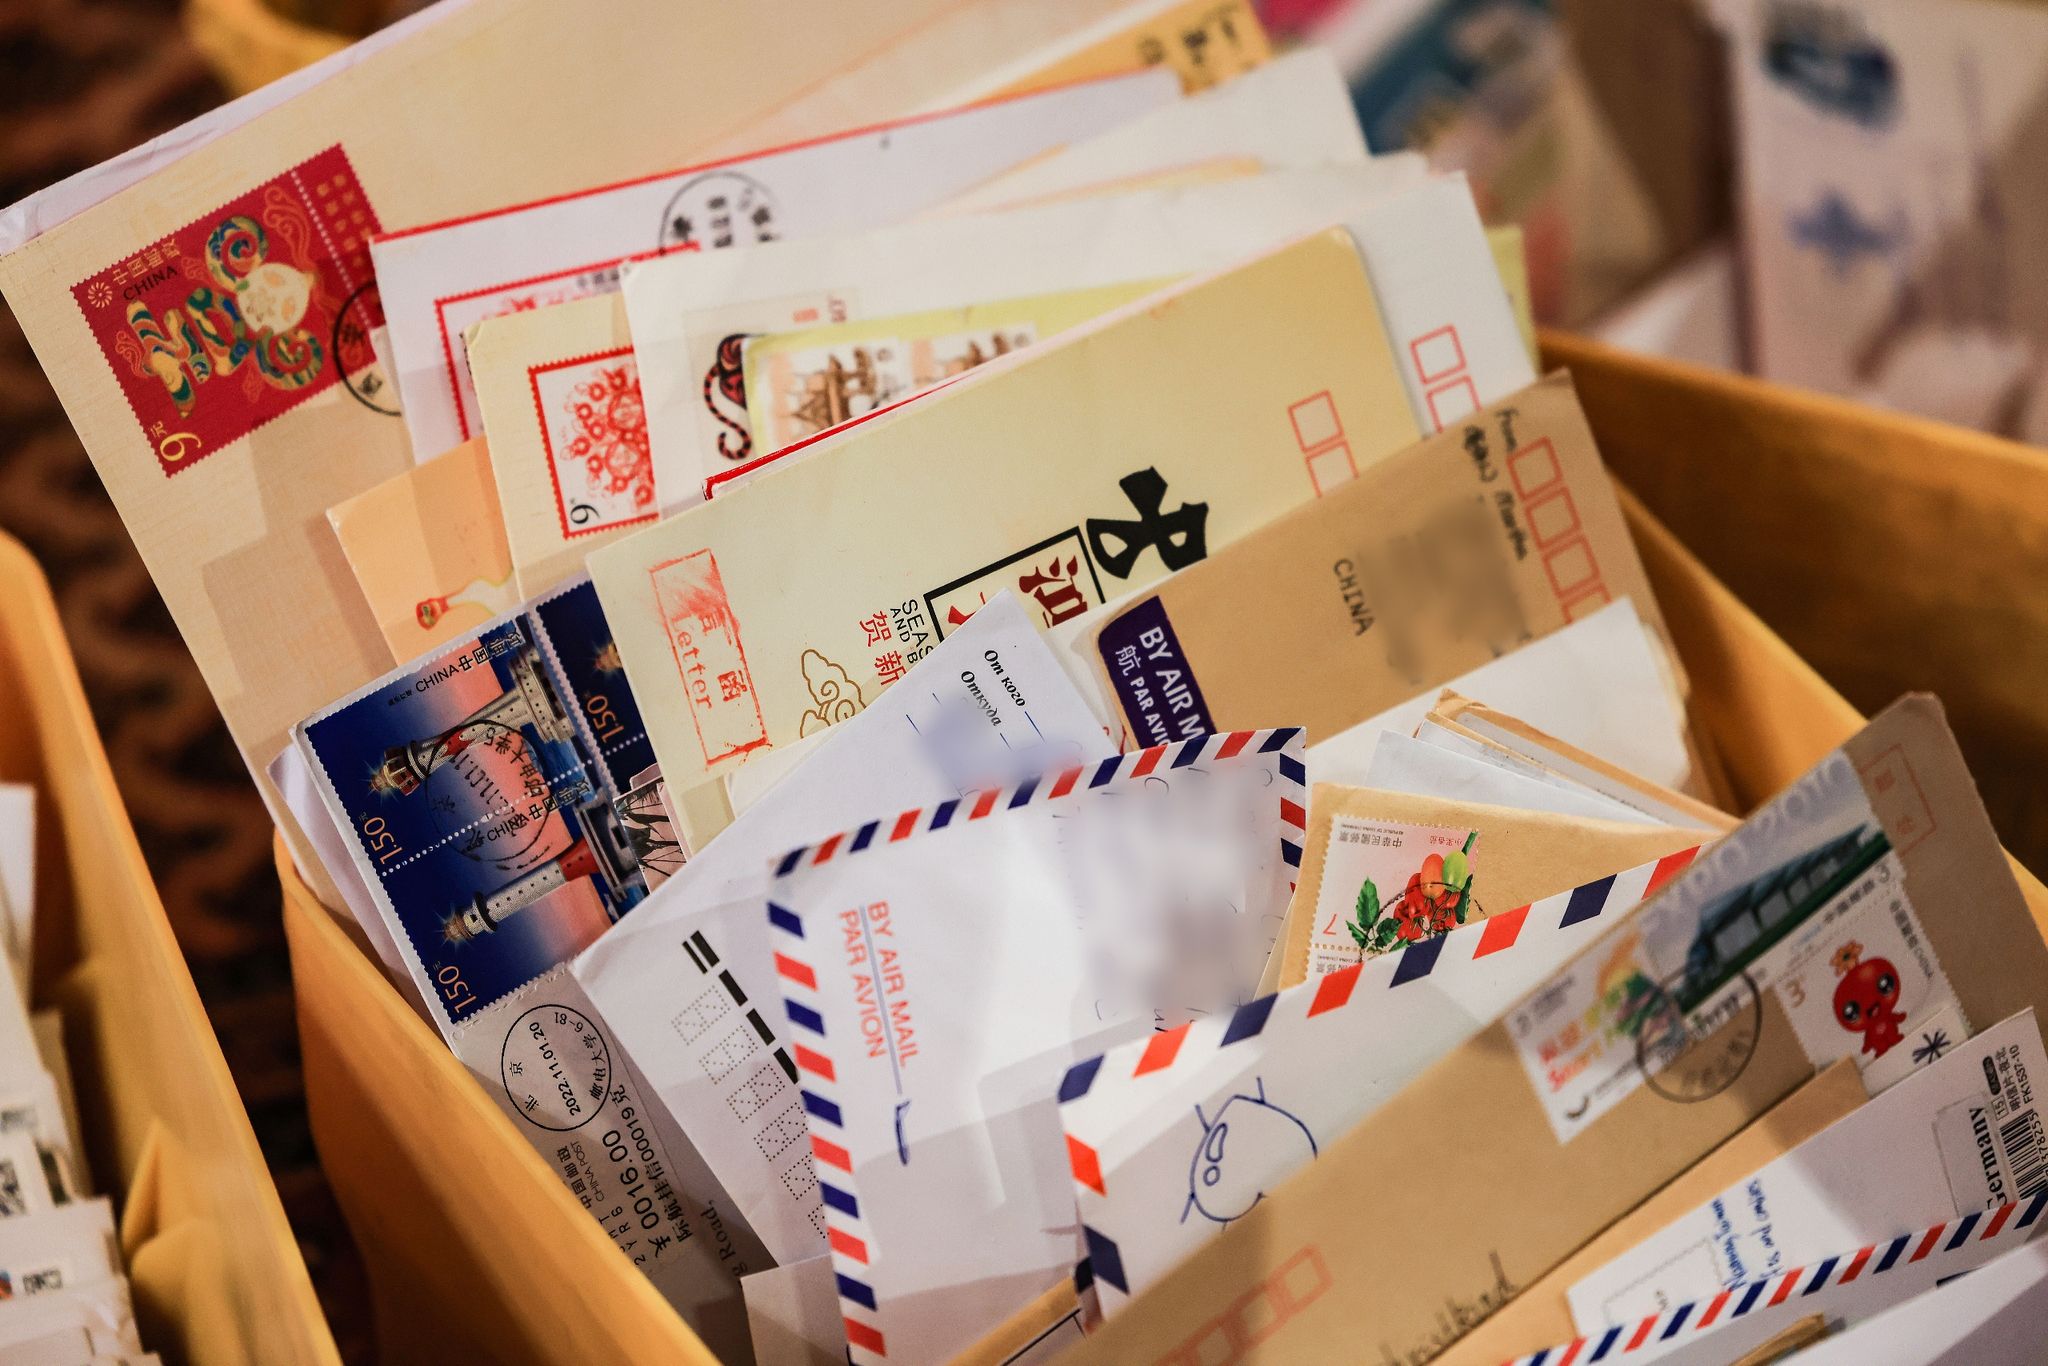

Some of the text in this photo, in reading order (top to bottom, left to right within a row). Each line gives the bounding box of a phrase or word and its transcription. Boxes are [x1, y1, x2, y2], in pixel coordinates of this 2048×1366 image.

[122, 263, 178, 301] CHINA
[890, 607, 911, 643] AND
[1333, 558, 1375, 637] CHINA
[1139, 626, 1173, 661] BY
[415, 664, 460, 694] CHINA
[961, 671, 1002, 726] Откуда
[984, 650, 1026, 707] От кого
[1130, 676, 1155, 712] PAR
[1155, 669, 1194, 714] AIR
[1322, 914, 1337, 935] 7
[839, 909, 887, 1058] PAR AVION
[867, 900, 919, 1068] BY AIR MAIL
[529, 1022, 581, 1116] 2022.11.01.20
[557, 1147, 592, 1209] 中国邮政
[570, 1141, 605, 1203] CHINA POST
[1969, 1106, 2008, 1210] Germany
[701, 1201, 735, 1263] Road,
